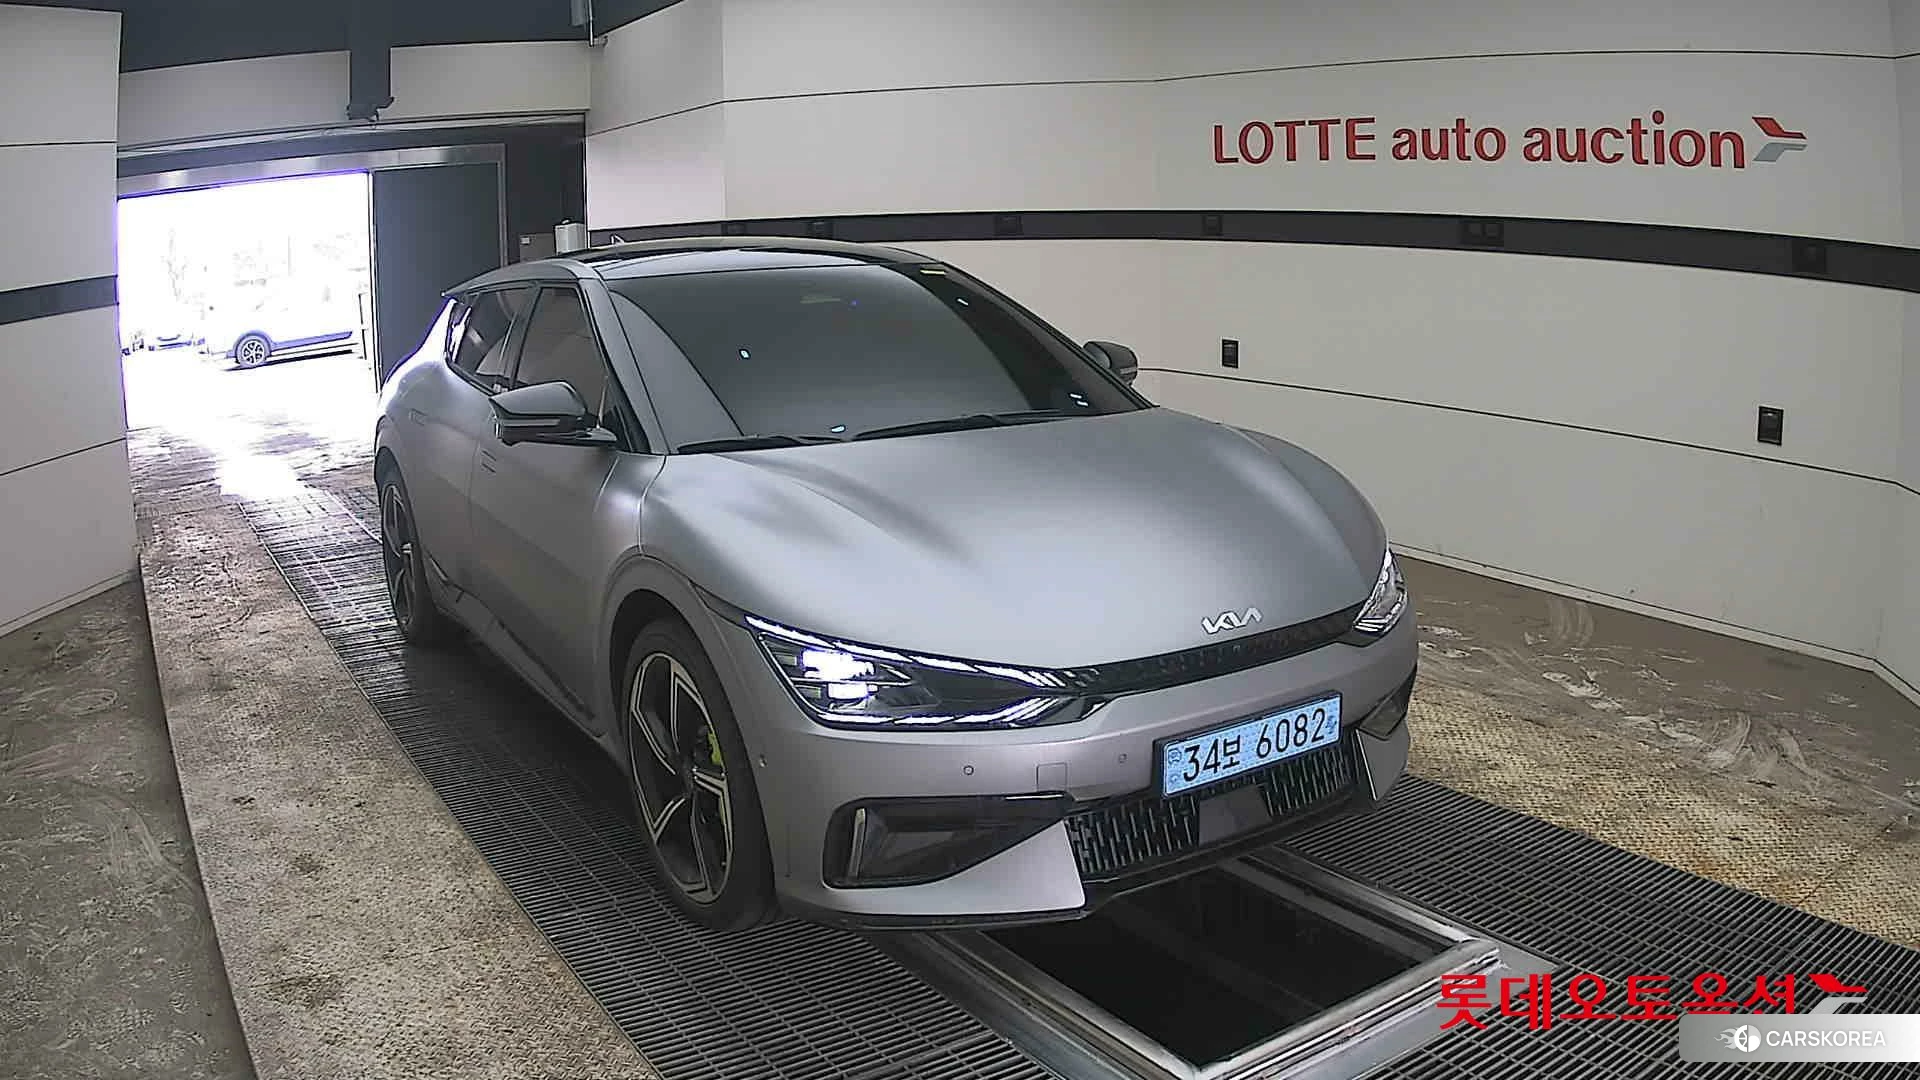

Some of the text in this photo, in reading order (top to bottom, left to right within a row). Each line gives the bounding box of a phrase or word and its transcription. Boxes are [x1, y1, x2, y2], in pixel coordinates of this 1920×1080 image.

[1213, 110, 1746, 169] LOTTE auto auction
[1183, 707, 1326, 782] 34보 6082
